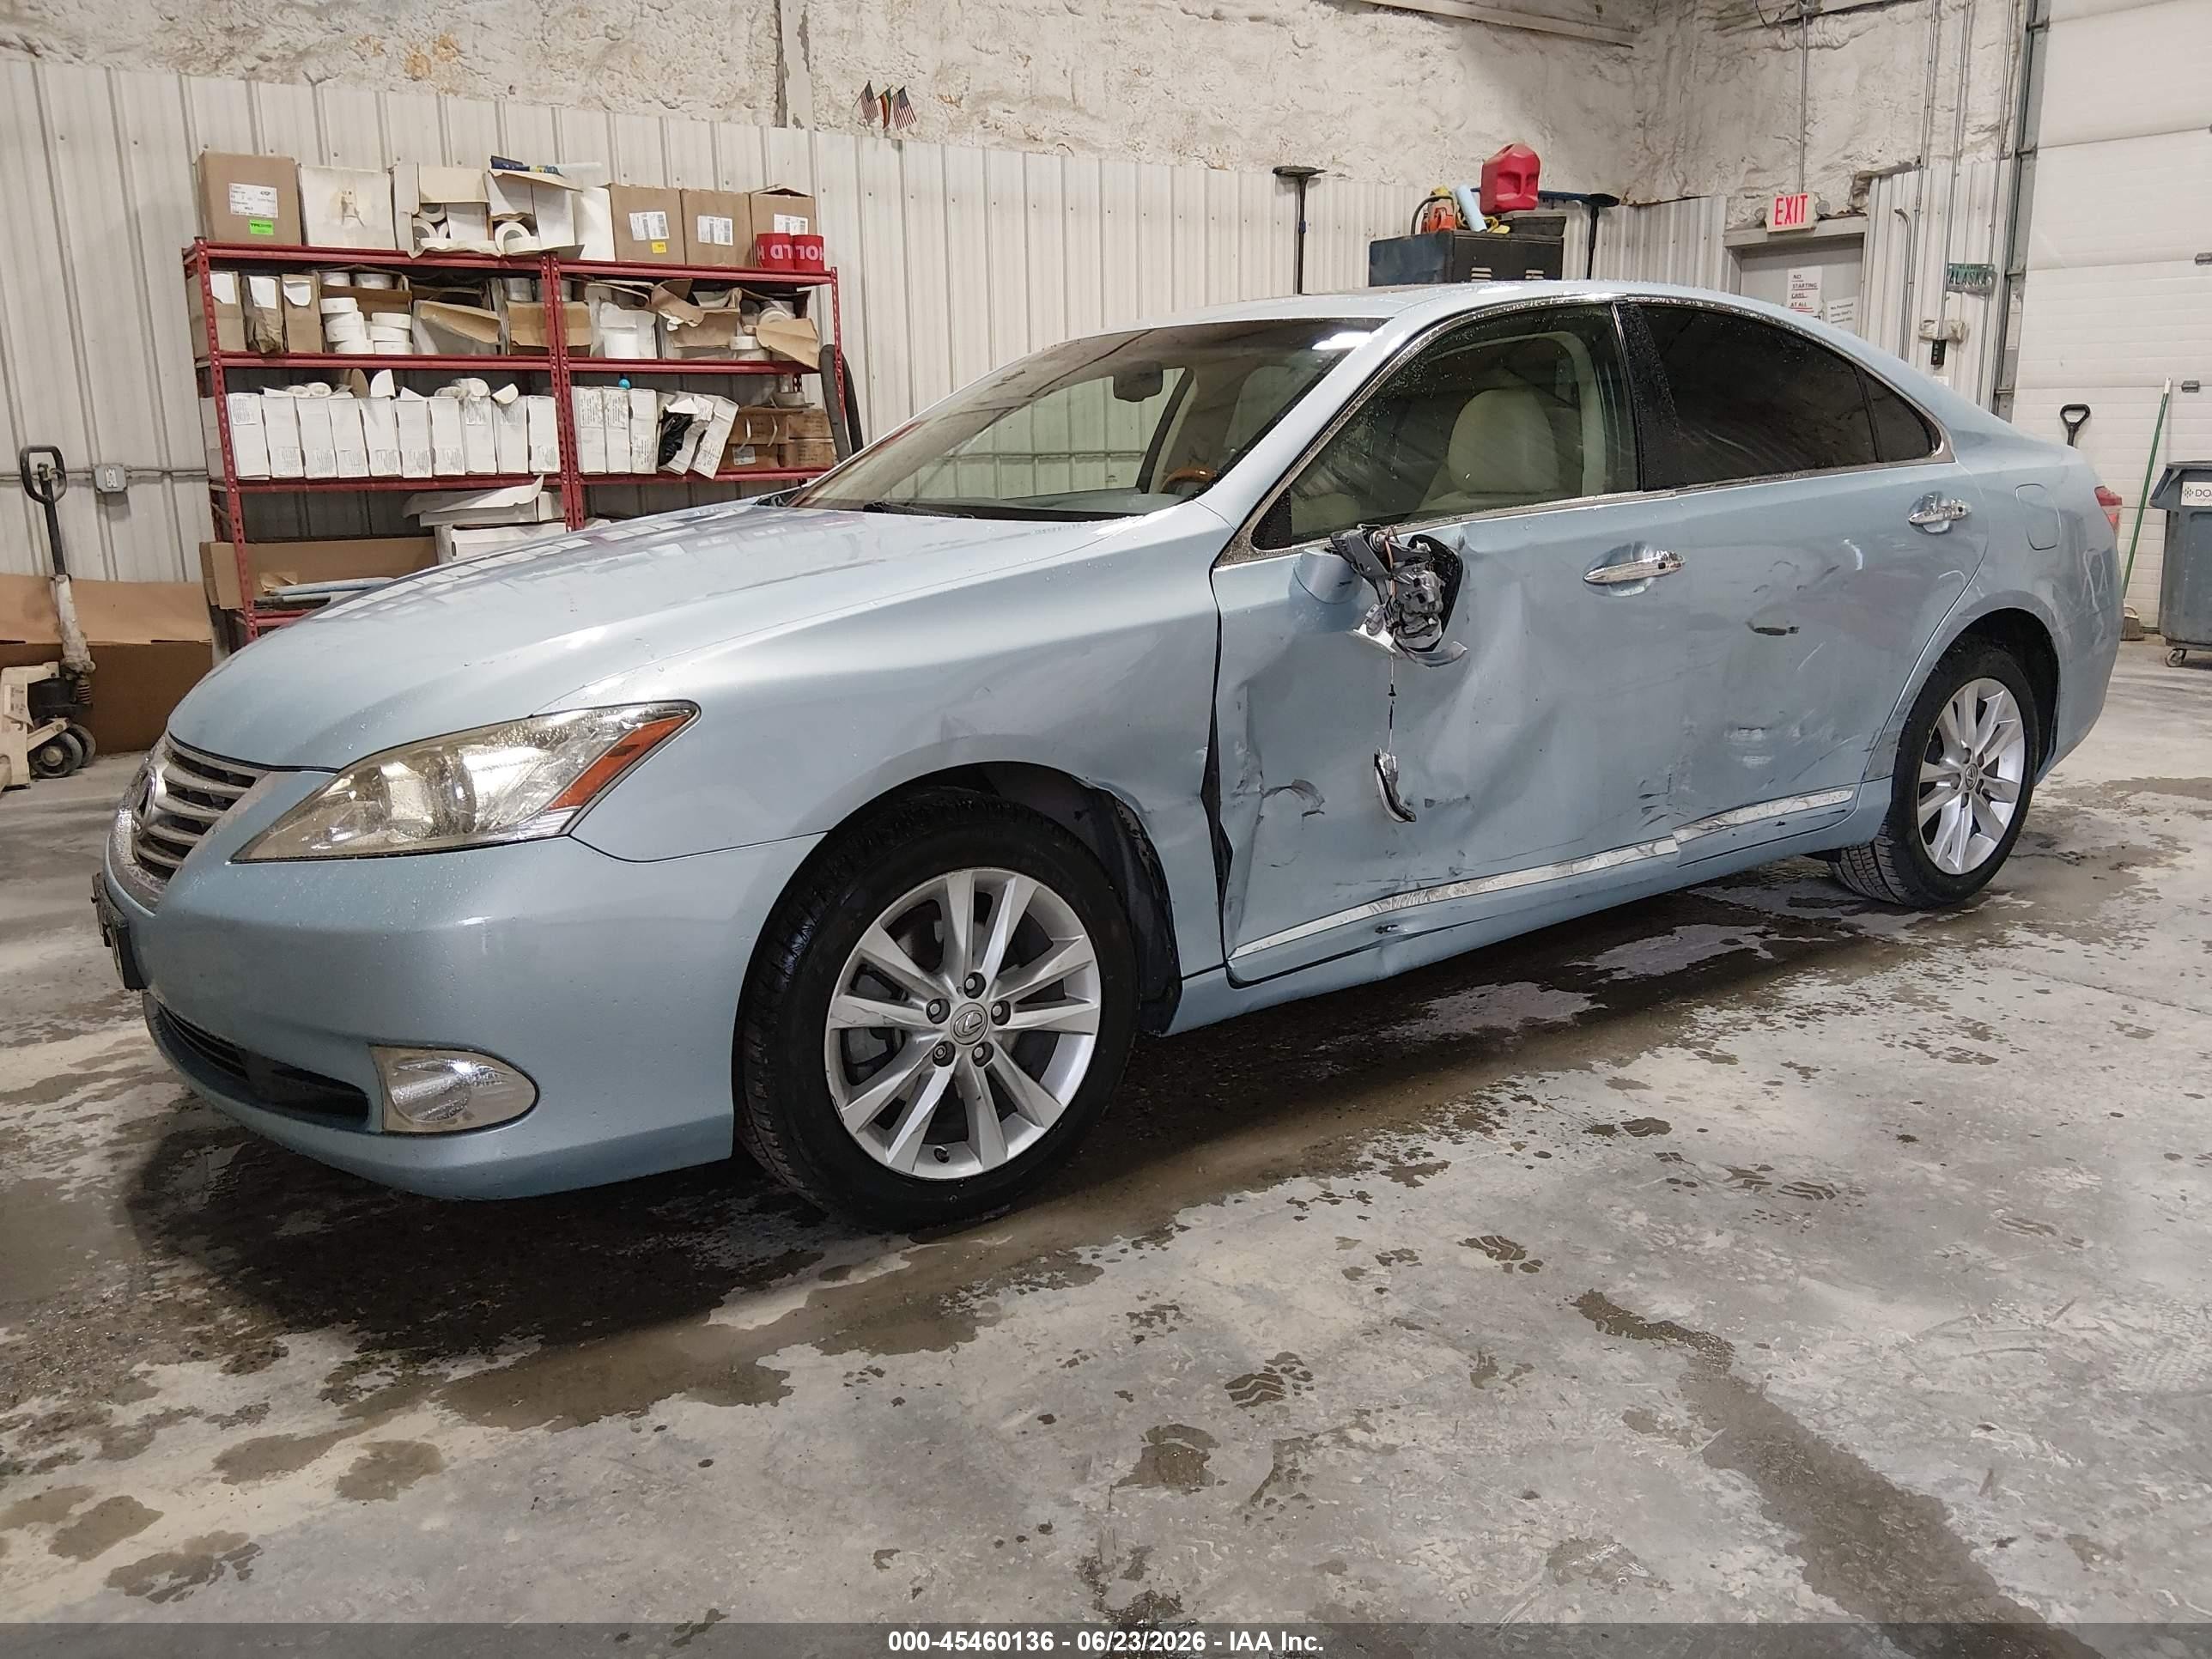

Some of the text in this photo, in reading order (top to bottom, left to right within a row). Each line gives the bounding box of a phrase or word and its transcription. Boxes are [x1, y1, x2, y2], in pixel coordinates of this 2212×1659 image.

[1775, 194, 1808, 226] EXIT
[1948, 270, 1987, 286] ALASKA
[2195, 489, 2212, 498] DO
